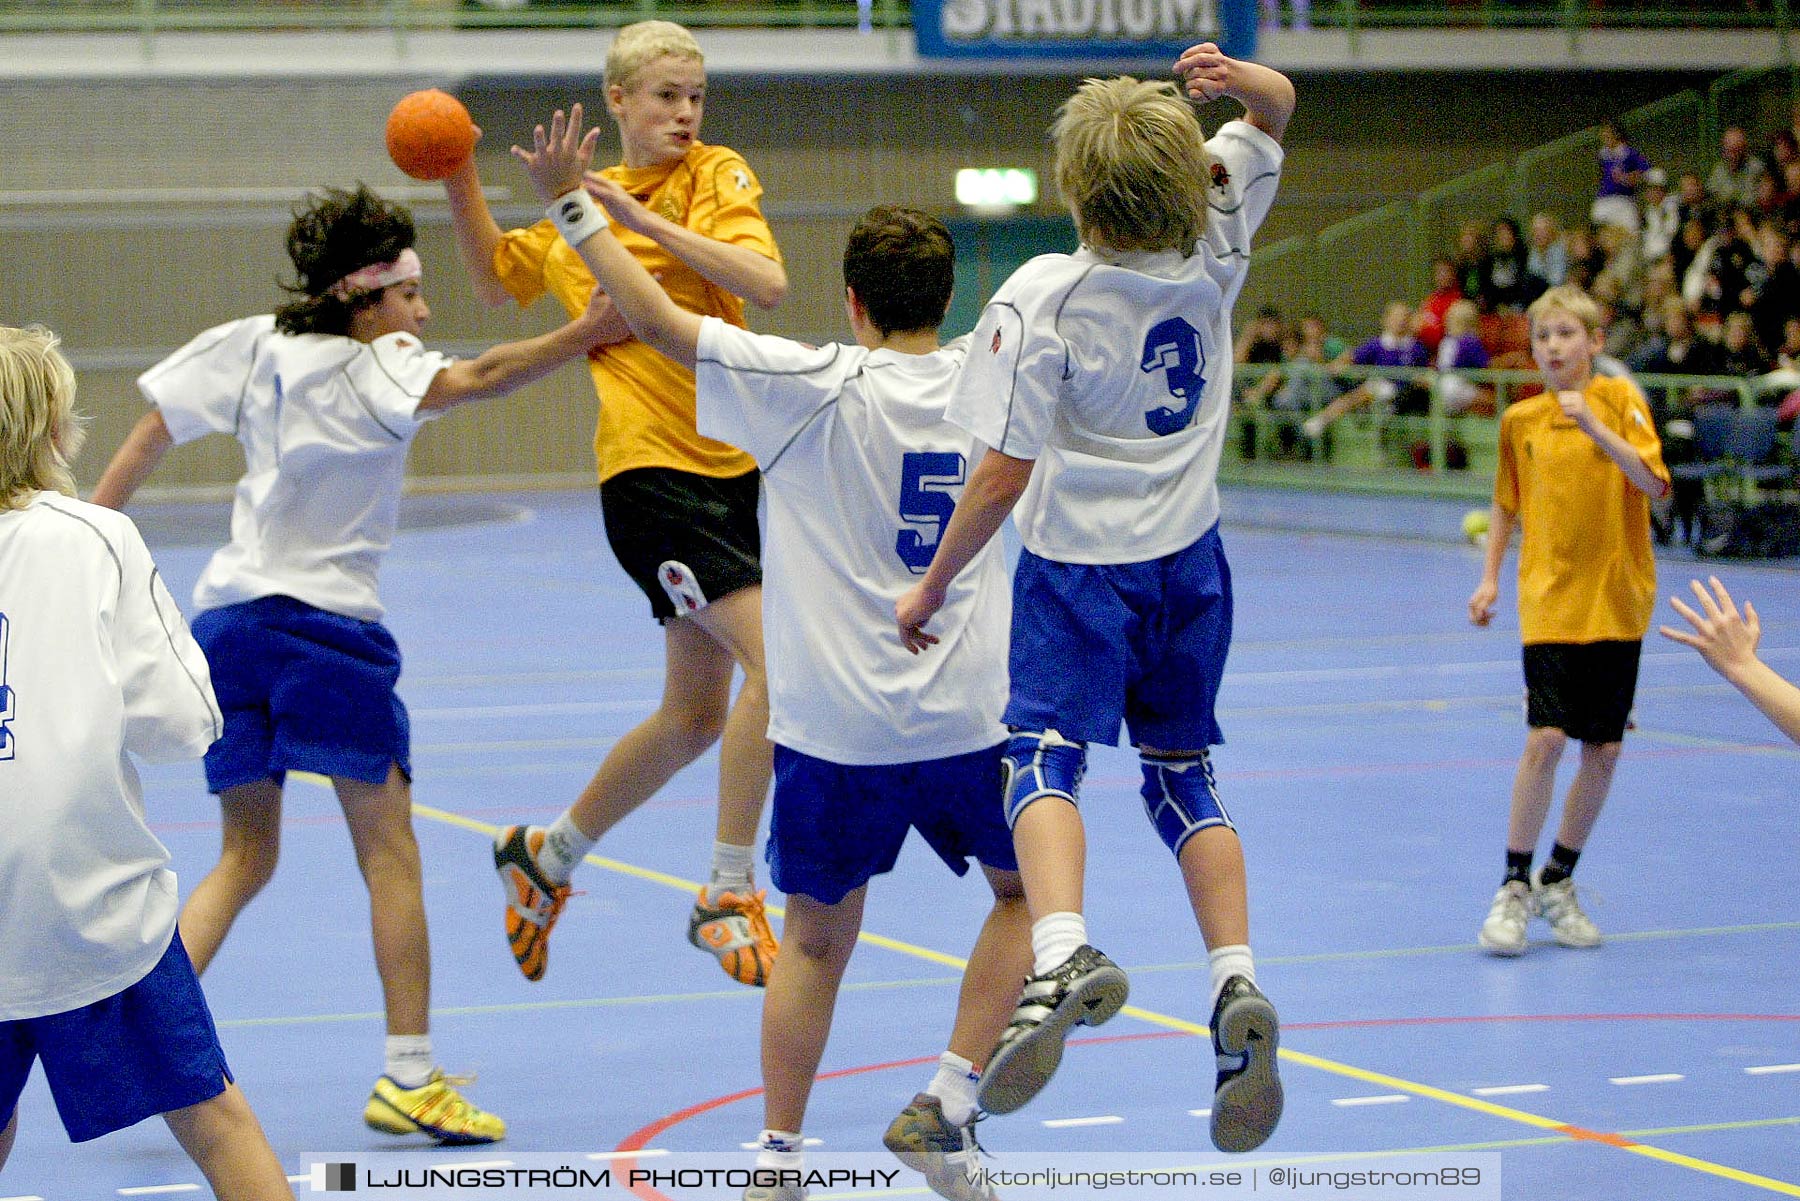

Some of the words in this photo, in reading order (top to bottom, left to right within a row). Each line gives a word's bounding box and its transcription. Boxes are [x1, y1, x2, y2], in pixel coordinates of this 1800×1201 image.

[941, 0, 1216, 37] STADIUM
[1141, 316, 1206, 437] 3
[896, 452, 967, 575] 5
